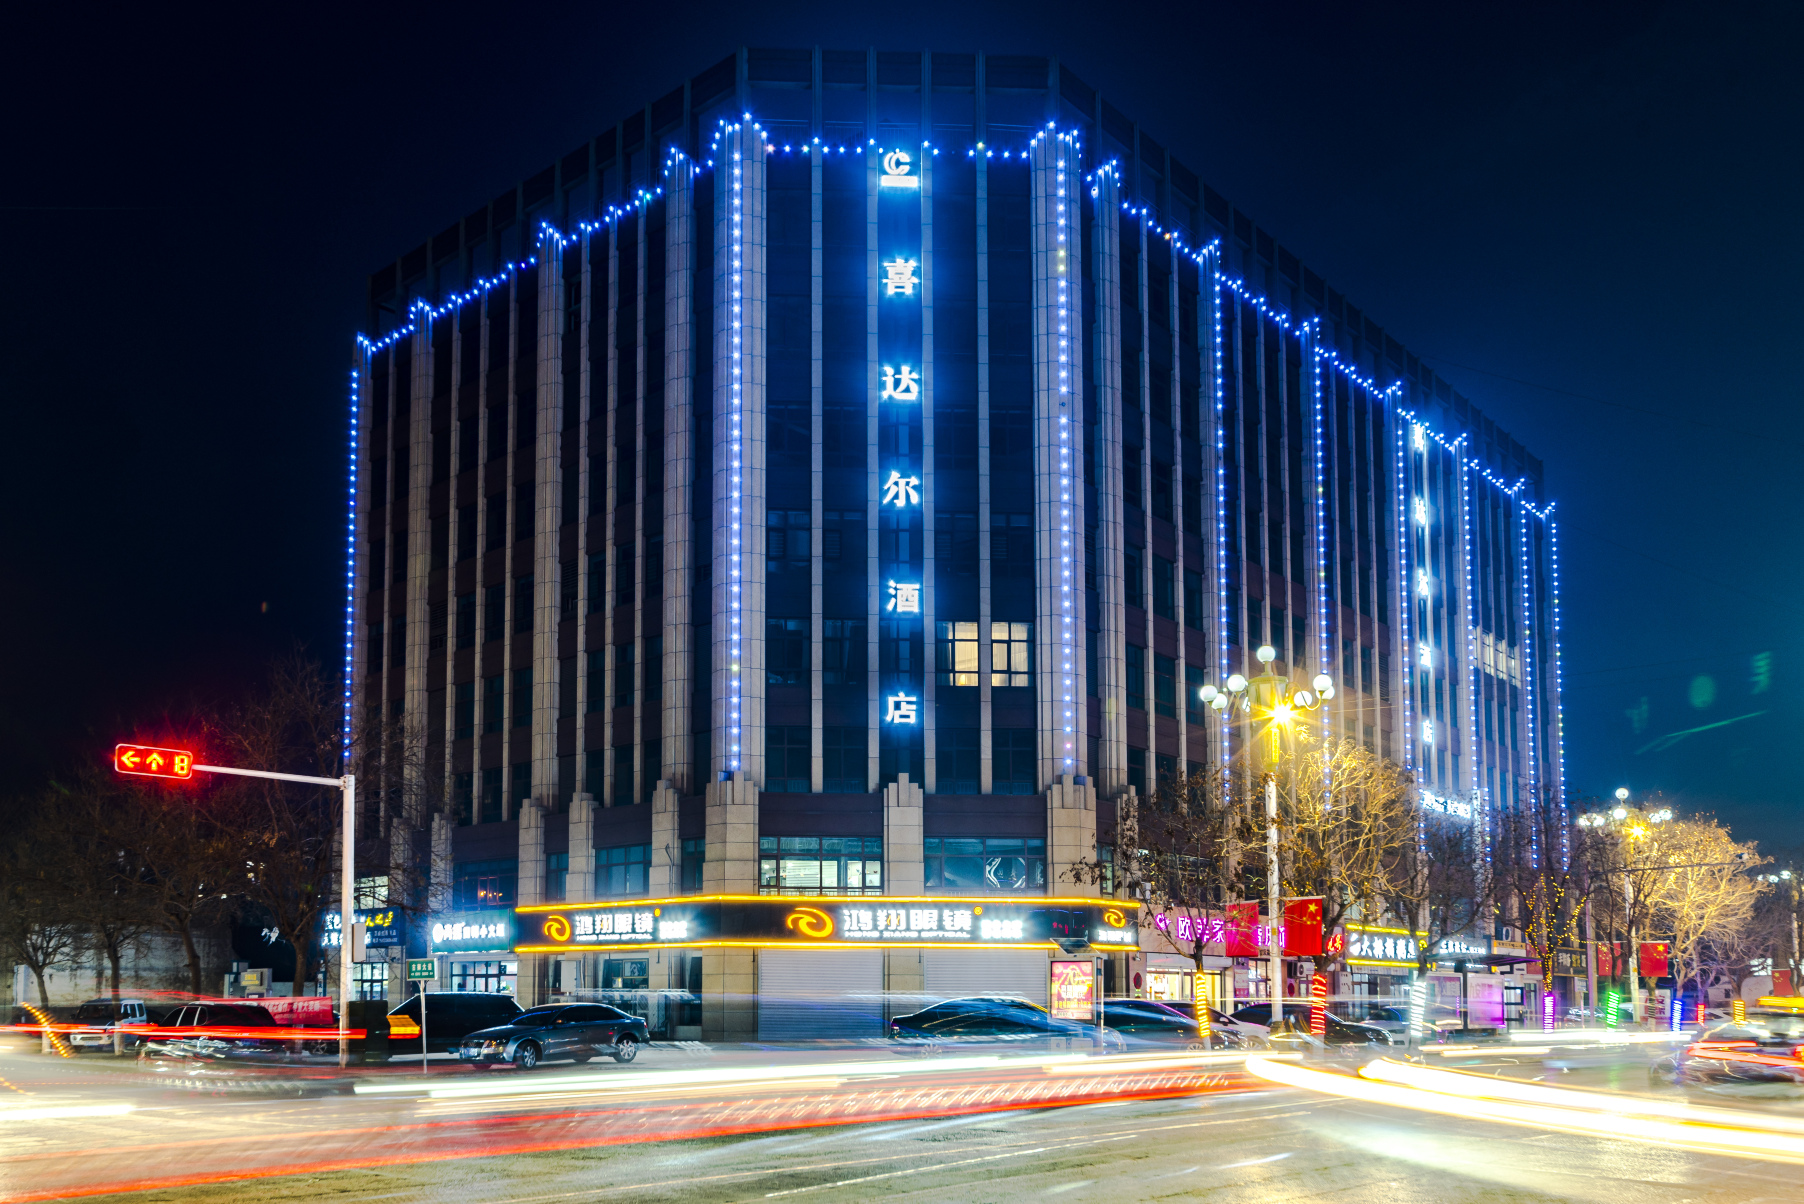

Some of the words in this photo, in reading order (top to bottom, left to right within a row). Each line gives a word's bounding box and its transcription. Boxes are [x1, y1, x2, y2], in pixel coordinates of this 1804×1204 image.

[882, 258, 920, 725] 喜达尔酒店
[575, 912, 653, 934] 鸿翔眼镜
[843, 909, 972, 930] 鸿翔眼镜
